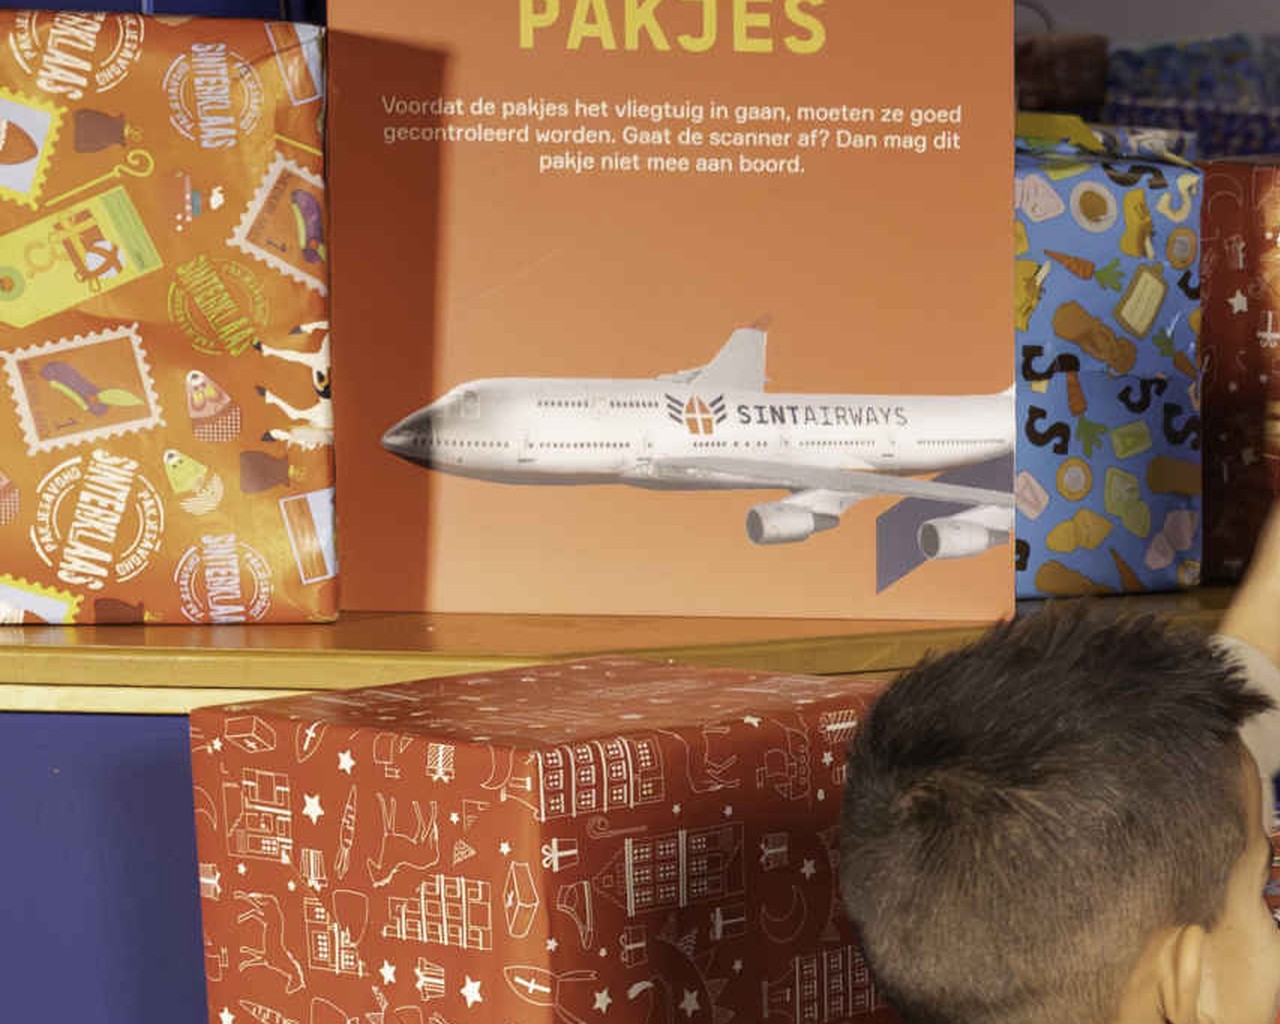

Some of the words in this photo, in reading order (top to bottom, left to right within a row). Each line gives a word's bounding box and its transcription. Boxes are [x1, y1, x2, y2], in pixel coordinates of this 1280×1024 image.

[519, 0, 828, 55] PAKJES
[191, 43, 238, 149] SINTERKLAAS
[383, 96, 464, 116] Voordat
[470, 97, 496, 117] de
[502, 98, 569, 121] pakjes
[575, 98, 608, 118] het
[615, 99, 704, 123] vliegtuig
[710, 101, 729, 119] in
[735, 103, 791, 124] gaan,
[797, 104, 875, 123] moeten
[881, 107, 904, 123] ze
[911, 105, 962, 126] goed
[383, 123, 530, 144] gecontroleerd
[536, 126, 616, 144] worden.
[622, 126, 671, 145] Gaat
[678, 128, 703, 146] de
[709, 131, 792, 147] scanner
[797, 129, 831, 148] af?
[836, 130, 877, 149] Dan
[884, 135, 928, 153] mag
[934, 131, 961, 150] dit
[540, 151, 595, 175] pakje
[601, 153, 641, 172] niet
[647, 157, 690, 172] mee
[695, 158, 734, 173] aan
[739, 154, 805, 174] boord.
[57, 448, 139, 590] SINTERKLAAS
